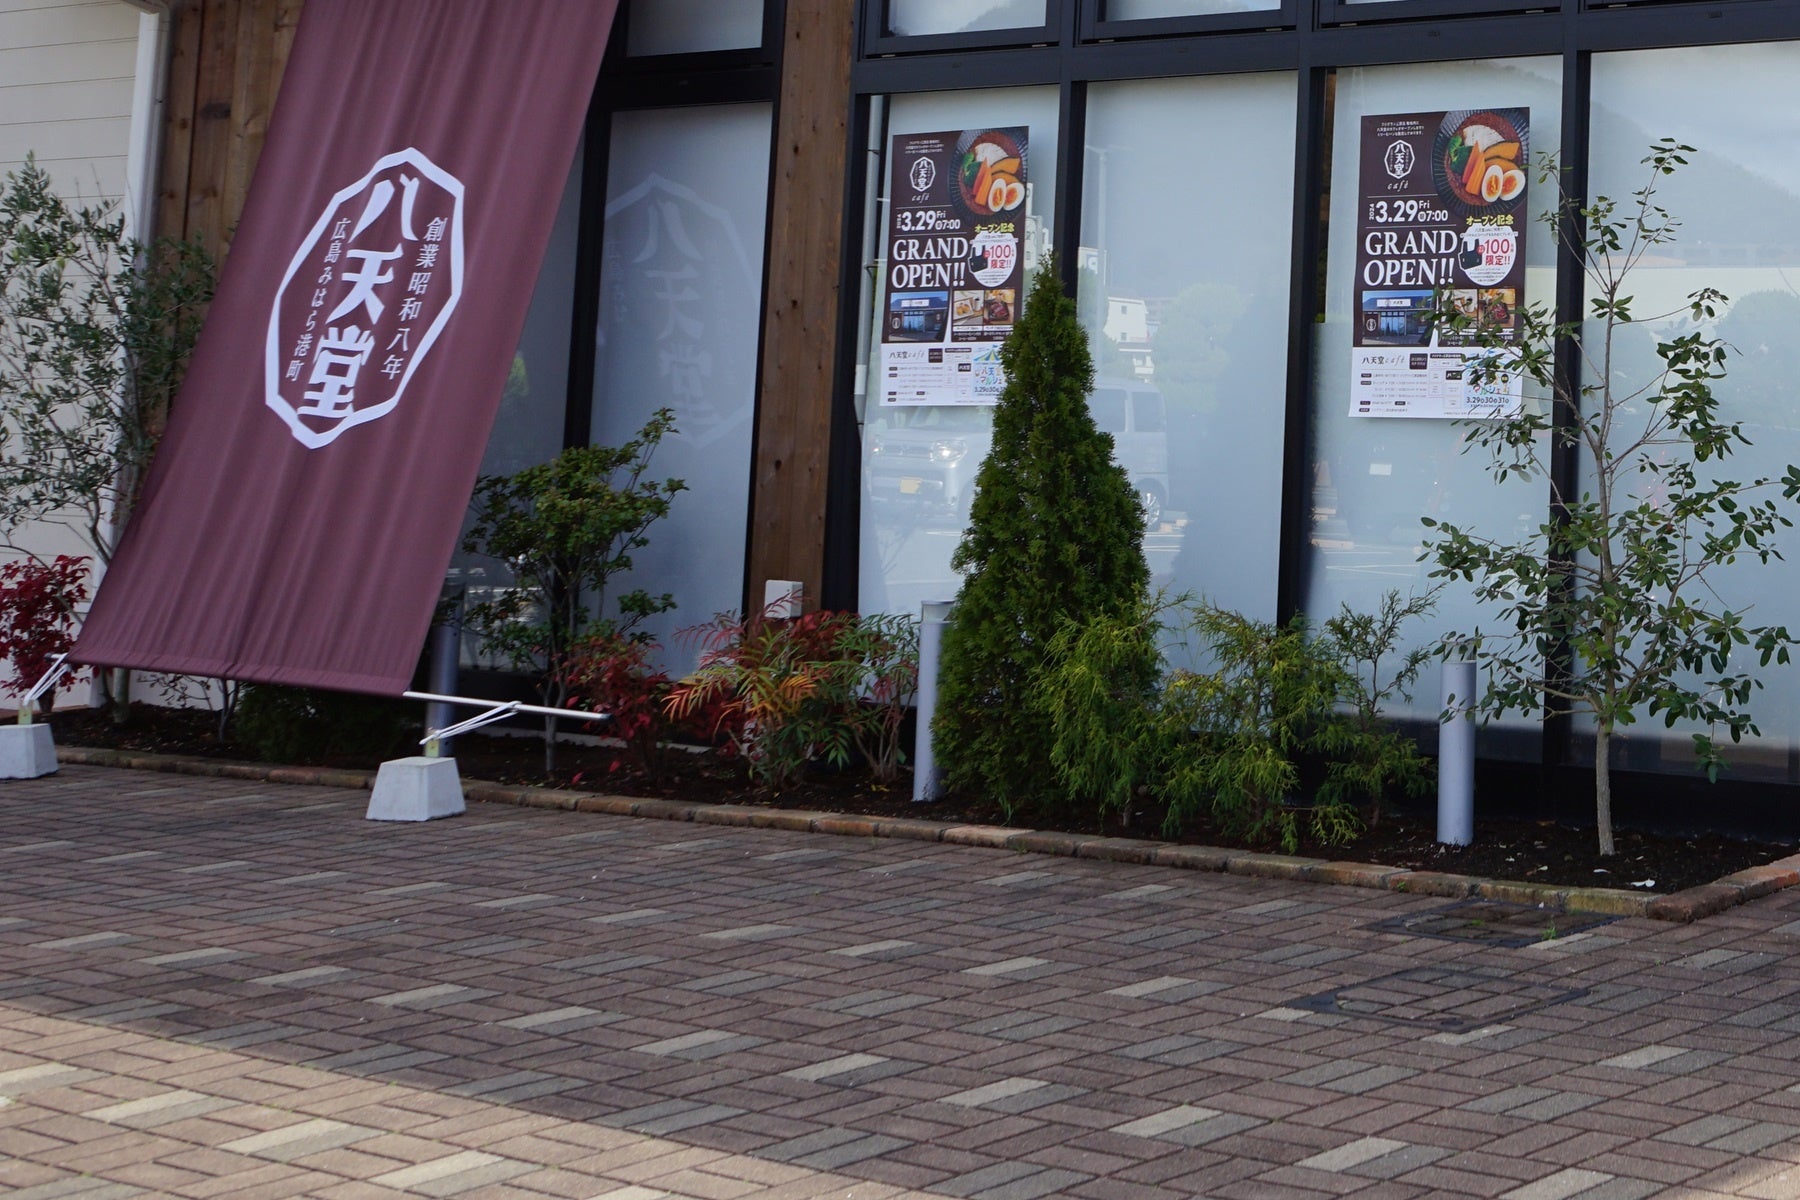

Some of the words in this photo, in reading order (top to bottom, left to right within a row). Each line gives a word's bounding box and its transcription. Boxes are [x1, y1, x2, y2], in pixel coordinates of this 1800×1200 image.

[1394, 143, 1406, 175] 八天堂
[901, 210, 936, 231] 3.29
[1375, 200, 1418, 222] 3.29
[1418, 200, 1430, 209] Fri
[1466, 214, 1514, 226] オープン記念
[893, 237, 968, 261] GRAND
[1365, 230, 1458, 256] GRAND
[891, 262, 966, 288] OPEN!!
[1363, 258, 1455, 286] OPEN!!
[286, 217, 351, 381] 広島みはら港町
[297, 173, 420, 418] 八天堂
[381, 217, 448, 380] 創業昭和八年
